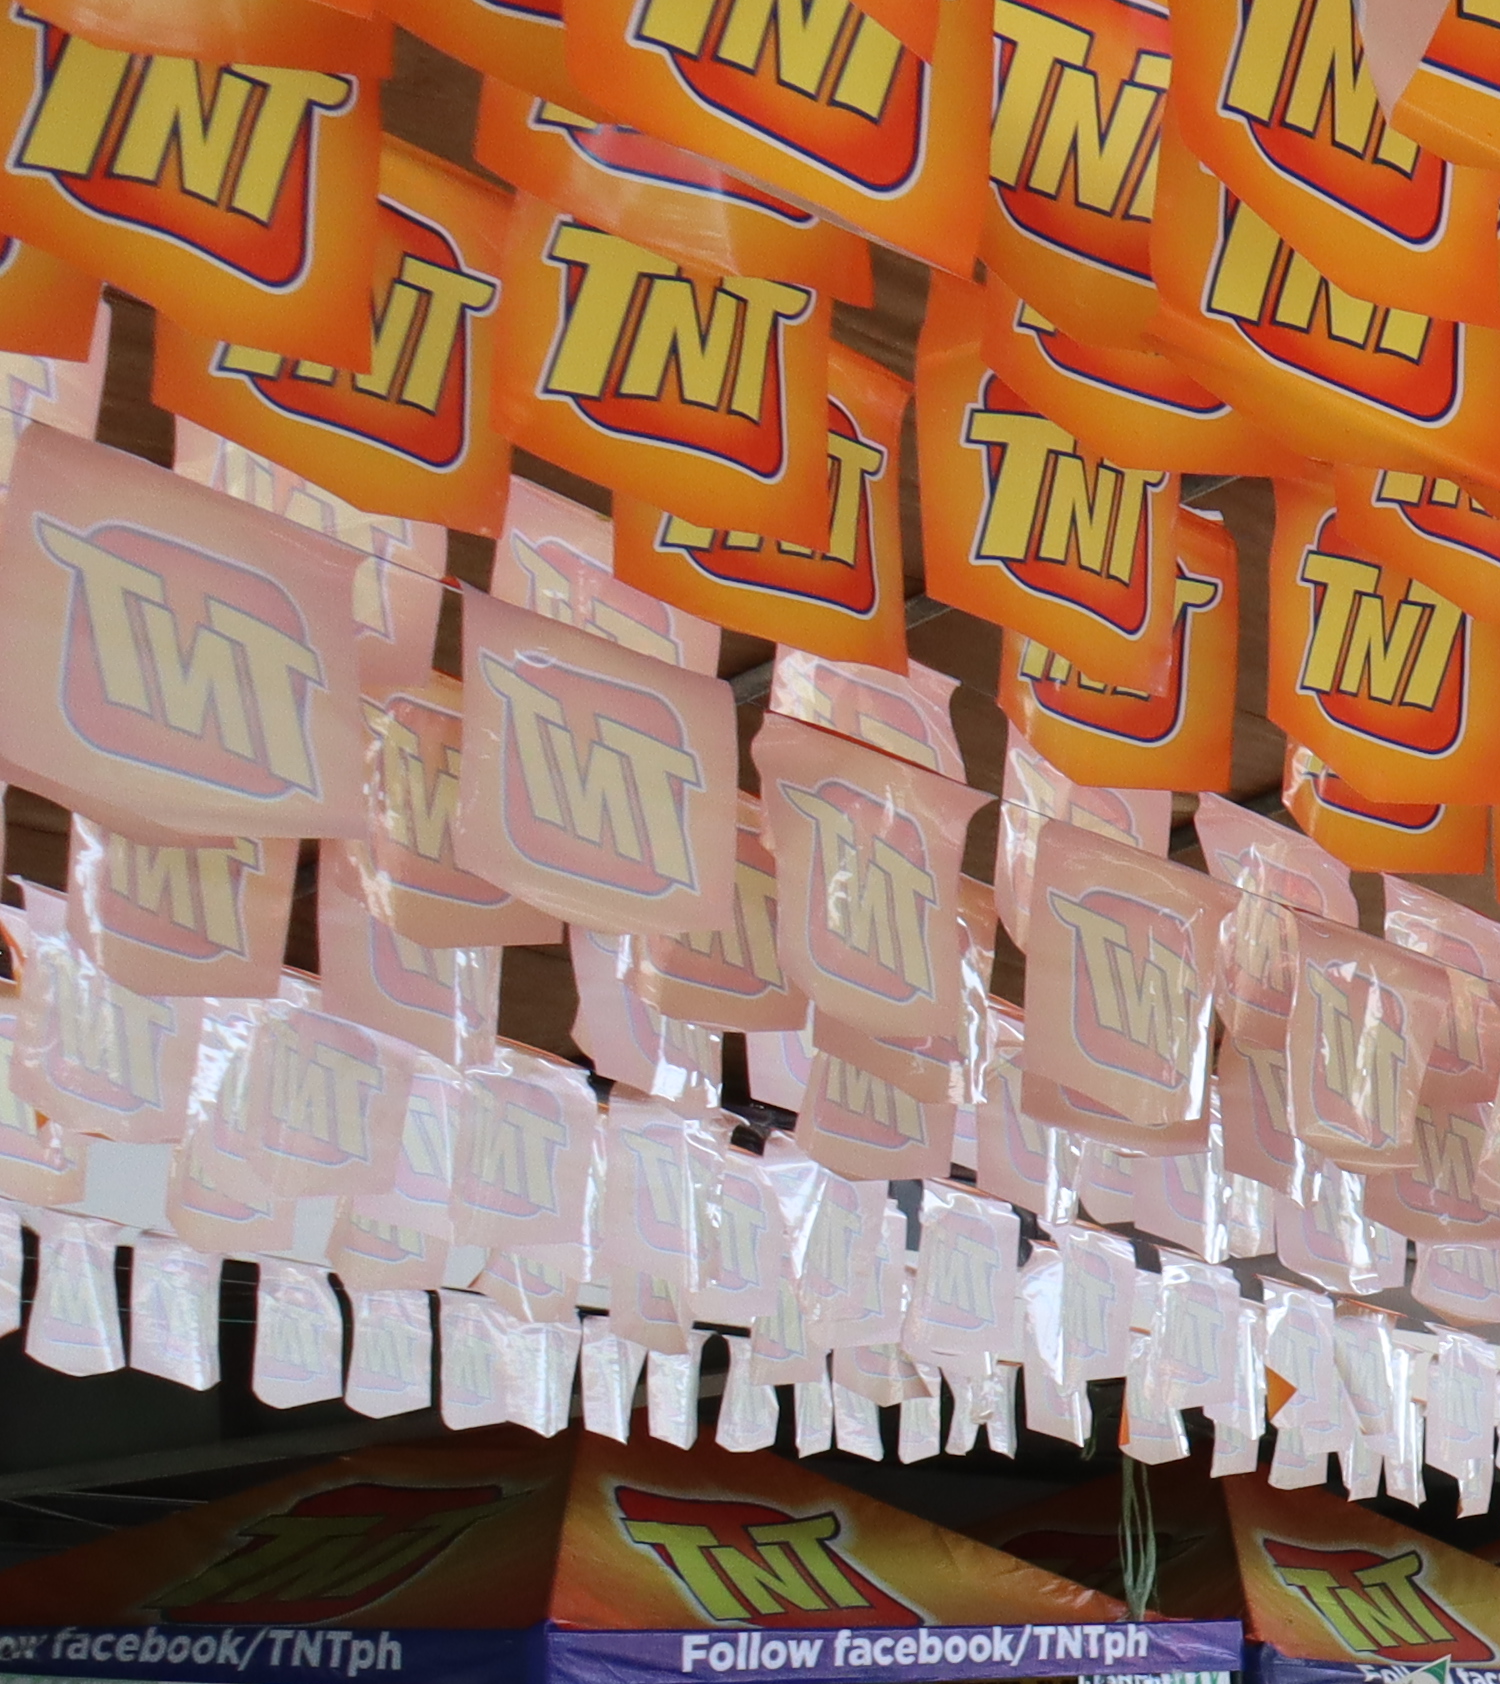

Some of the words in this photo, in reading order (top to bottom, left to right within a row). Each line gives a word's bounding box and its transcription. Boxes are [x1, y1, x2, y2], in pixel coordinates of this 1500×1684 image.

[543, 219, 815, 426] TNT
[621, 1513, 873, 1623] TNT
[1276, 1551, 1456, 1652] TNT
[52, 1625, 402, 1677] facebook/TNTph
[682, 1630, 820, 1673] Follow
[834, 1622, 1148, 1667] facebook/TNTph
